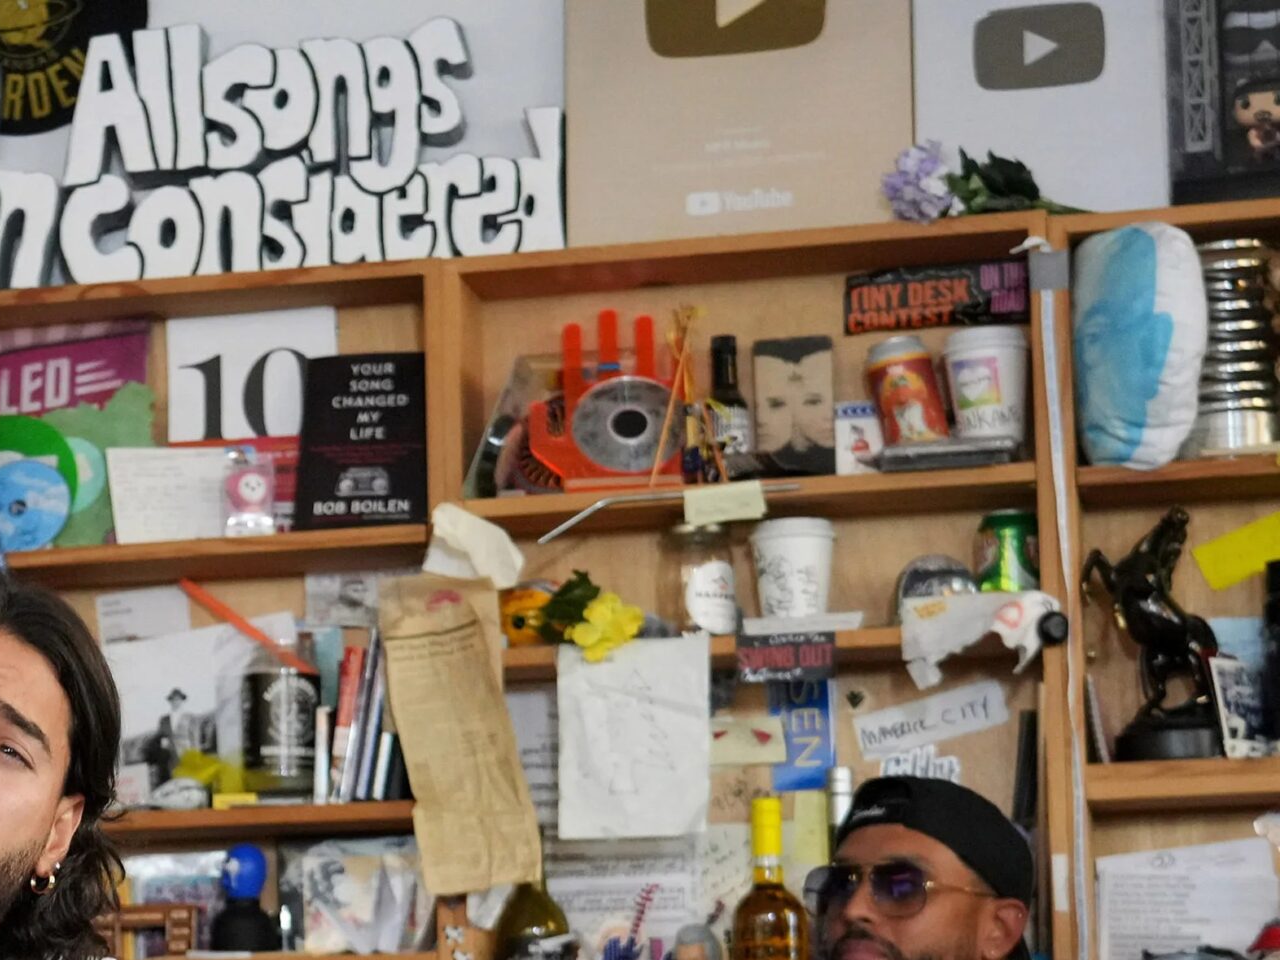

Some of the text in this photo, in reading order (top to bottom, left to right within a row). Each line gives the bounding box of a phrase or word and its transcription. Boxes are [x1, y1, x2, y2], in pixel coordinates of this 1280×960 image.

[65, 16, 475, 195] Allsongs
[58, 107, 566, 286] Considered
[850, 278, 970, 312] TINY DESK
[848, 304, 954, 334] CONTEST
[351, 362, 396, 376] YOUR
[177, 346, 309, 441] 10
[349, 378, 395, 392] SONG
[332, 394, 409, 409] CHANGED
[356, 410, 382, 424] MY
[349, 426, 386, 441] LIFE
[313, 498, 411, 516] BOB BOILEN
[941, 695, 990, 725] CITY
